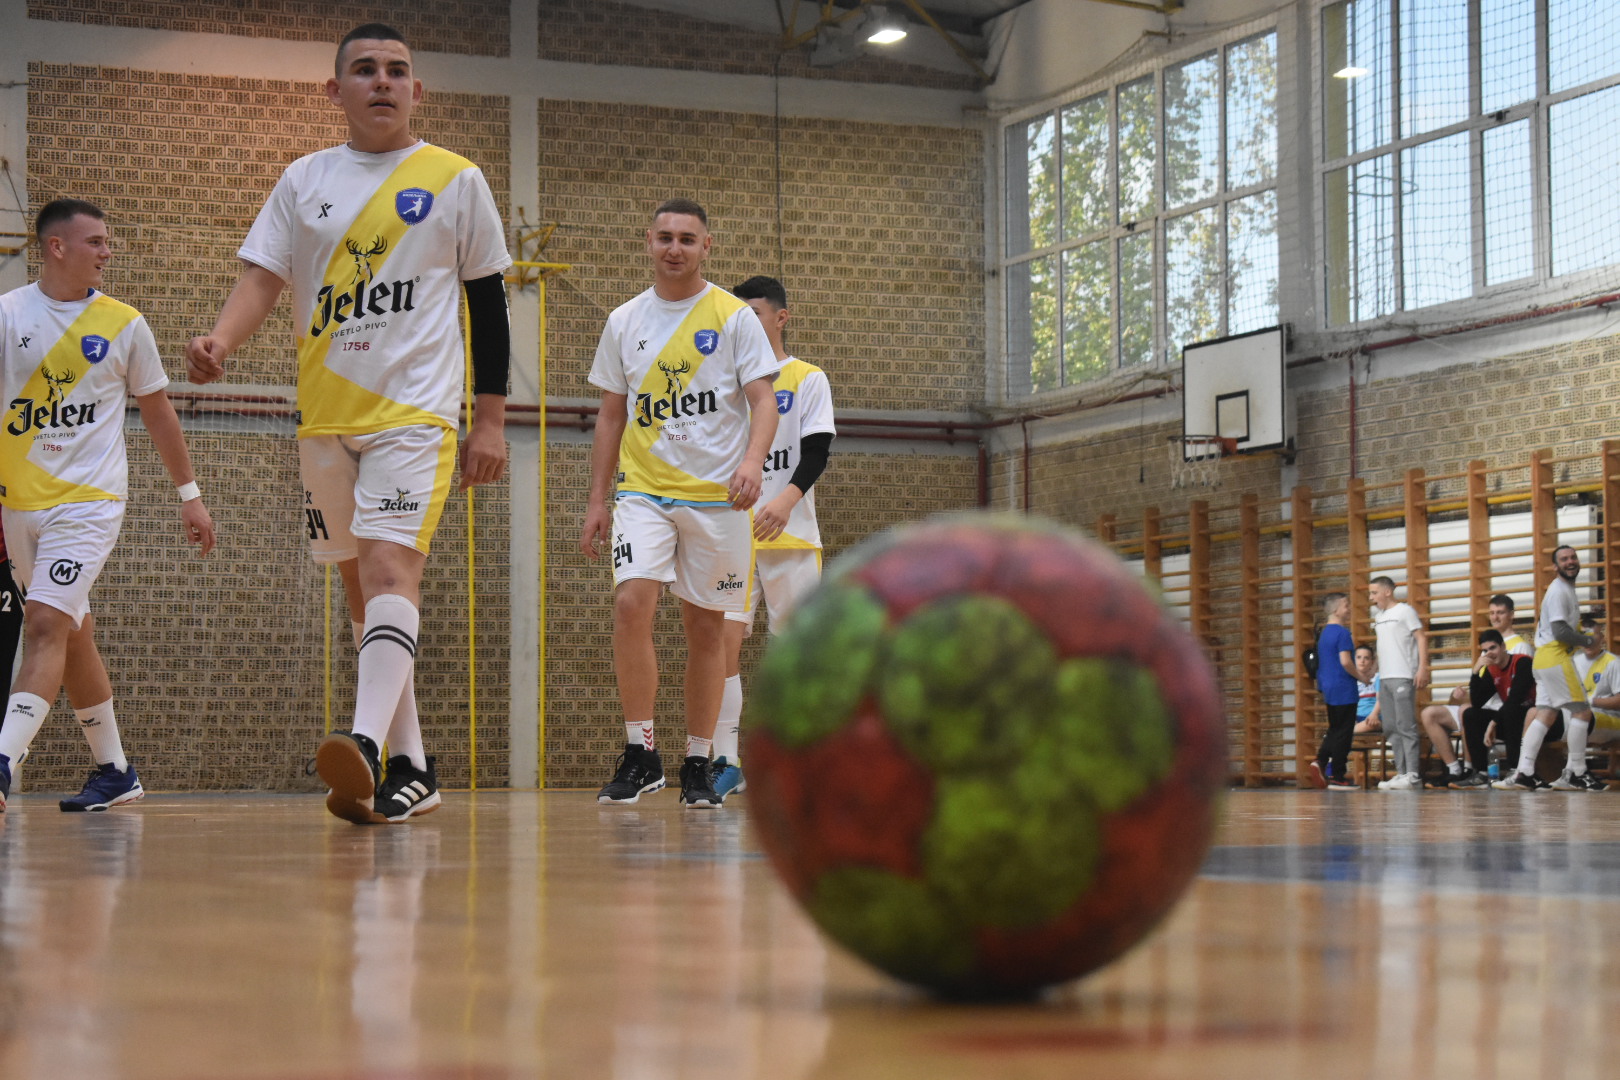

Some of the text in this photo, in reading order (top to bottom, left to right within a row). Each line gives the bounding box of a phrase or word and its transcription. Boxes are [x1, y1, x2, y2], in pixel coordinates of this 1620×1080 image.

[330, 321, 387, 339] SVETLO PIVO
[343, 341, 370, 351] 1756
[682, 420, 697, 428] PIVO
[667, 433, 688, 441] 1756
[42, 443, 62, 452] 1756
[613, 542, 633, 569] 24
